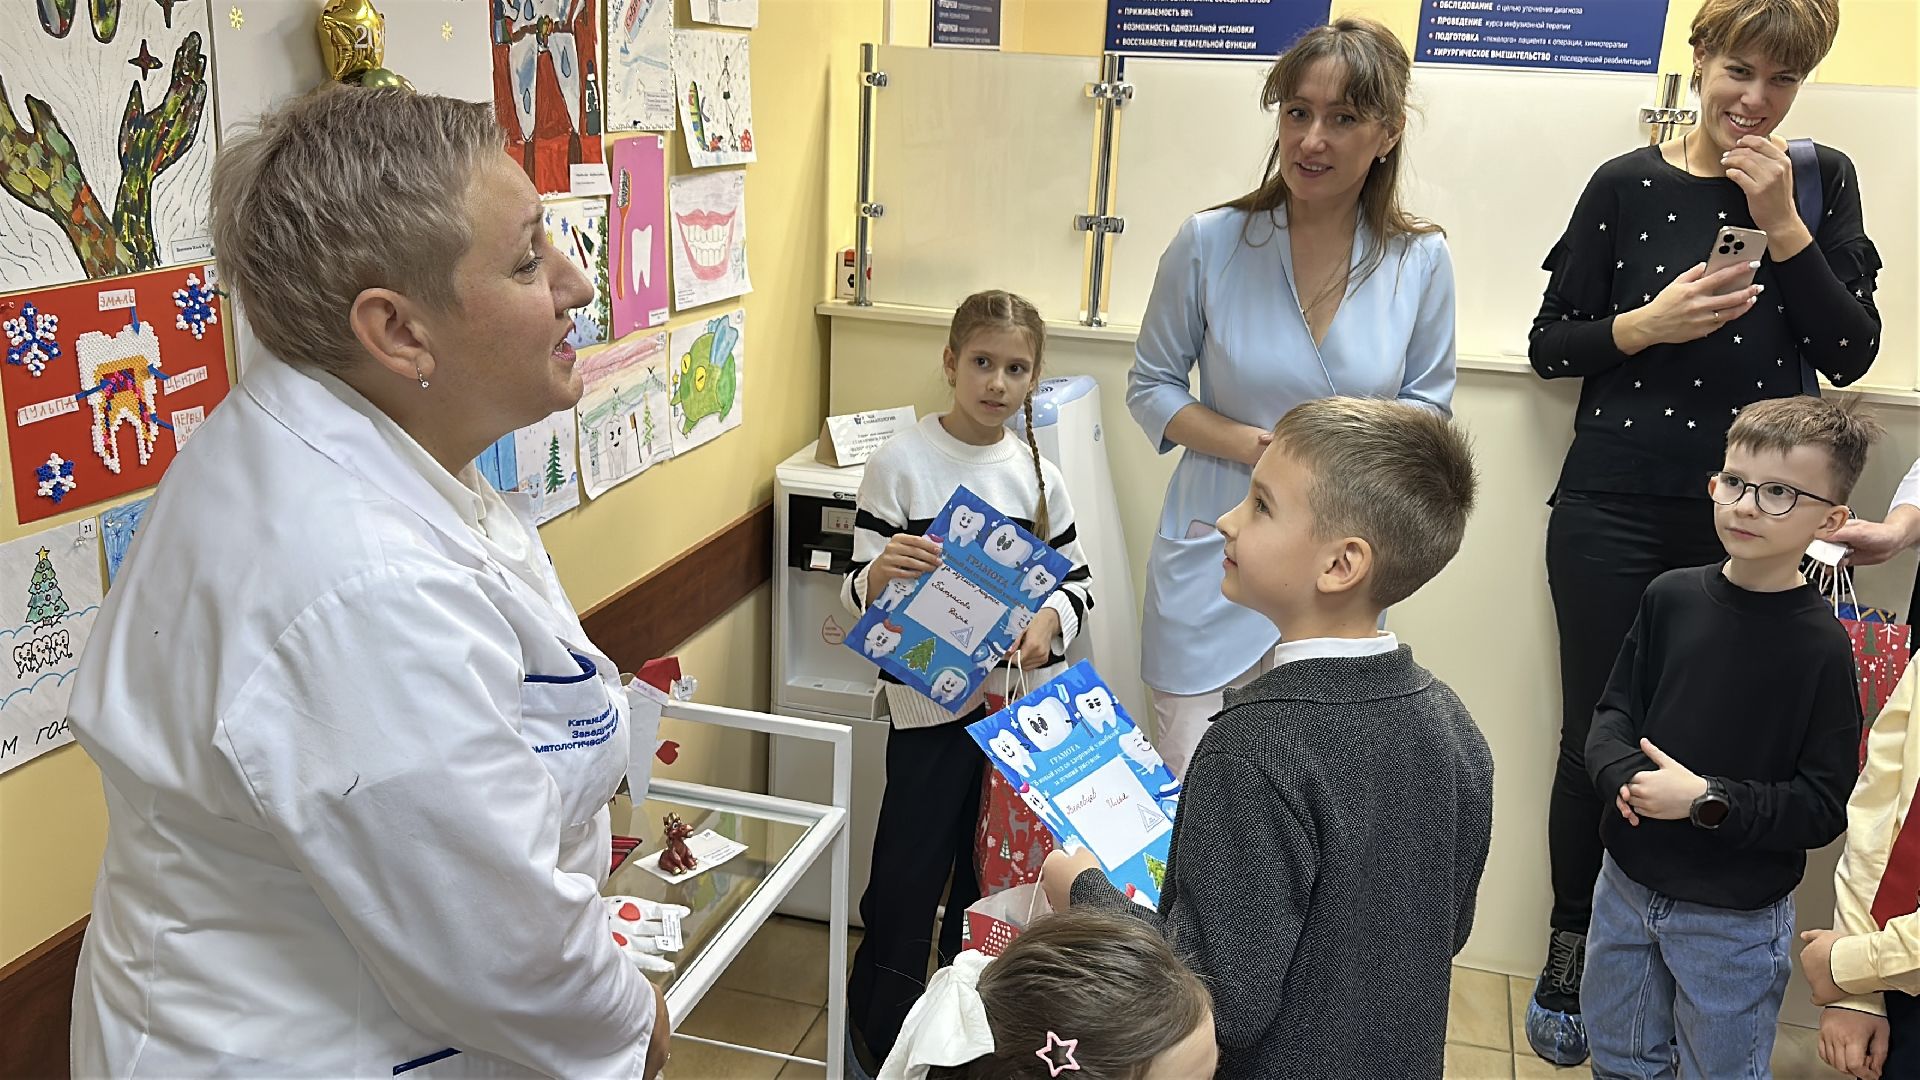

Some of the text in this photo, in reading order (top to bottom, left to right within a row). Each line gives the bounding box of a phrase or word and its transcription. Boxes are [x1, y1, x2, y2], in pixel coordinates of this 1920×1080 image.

[1124, 7, 1180, 17] ПРИЖИВАЕМОСТЬ
[1437, 16, 1482, 27] ПРОВЕДЕНИЕ
[1122, 22, 1255, 35] ВОЗМОЖНОСТЬ ОДНОЭТАПНОЙ УСТАНОВКИ
[1435, 31, 1480, 42] ПОДГОТОВКА
[1178, 38, 1224, 49] ЖЕВАТЕЛЬНОЙ
[1224, 40, 1257, 50] ФУНКЦИИ
[1433, 47, 1490, 58] ХИРУРГИЧЕСКОЕ
[1490, 50, 1551, 62] ВМЕШАТЕЛЬСТВО
[99, 290, 136, 308] ЭМАЛЬ
[19, 396, 78, 422] ПУЛЬПА
[84, 525, 92, 534] 21
[1049, 743, 1081, 766] ГРАМОТА
